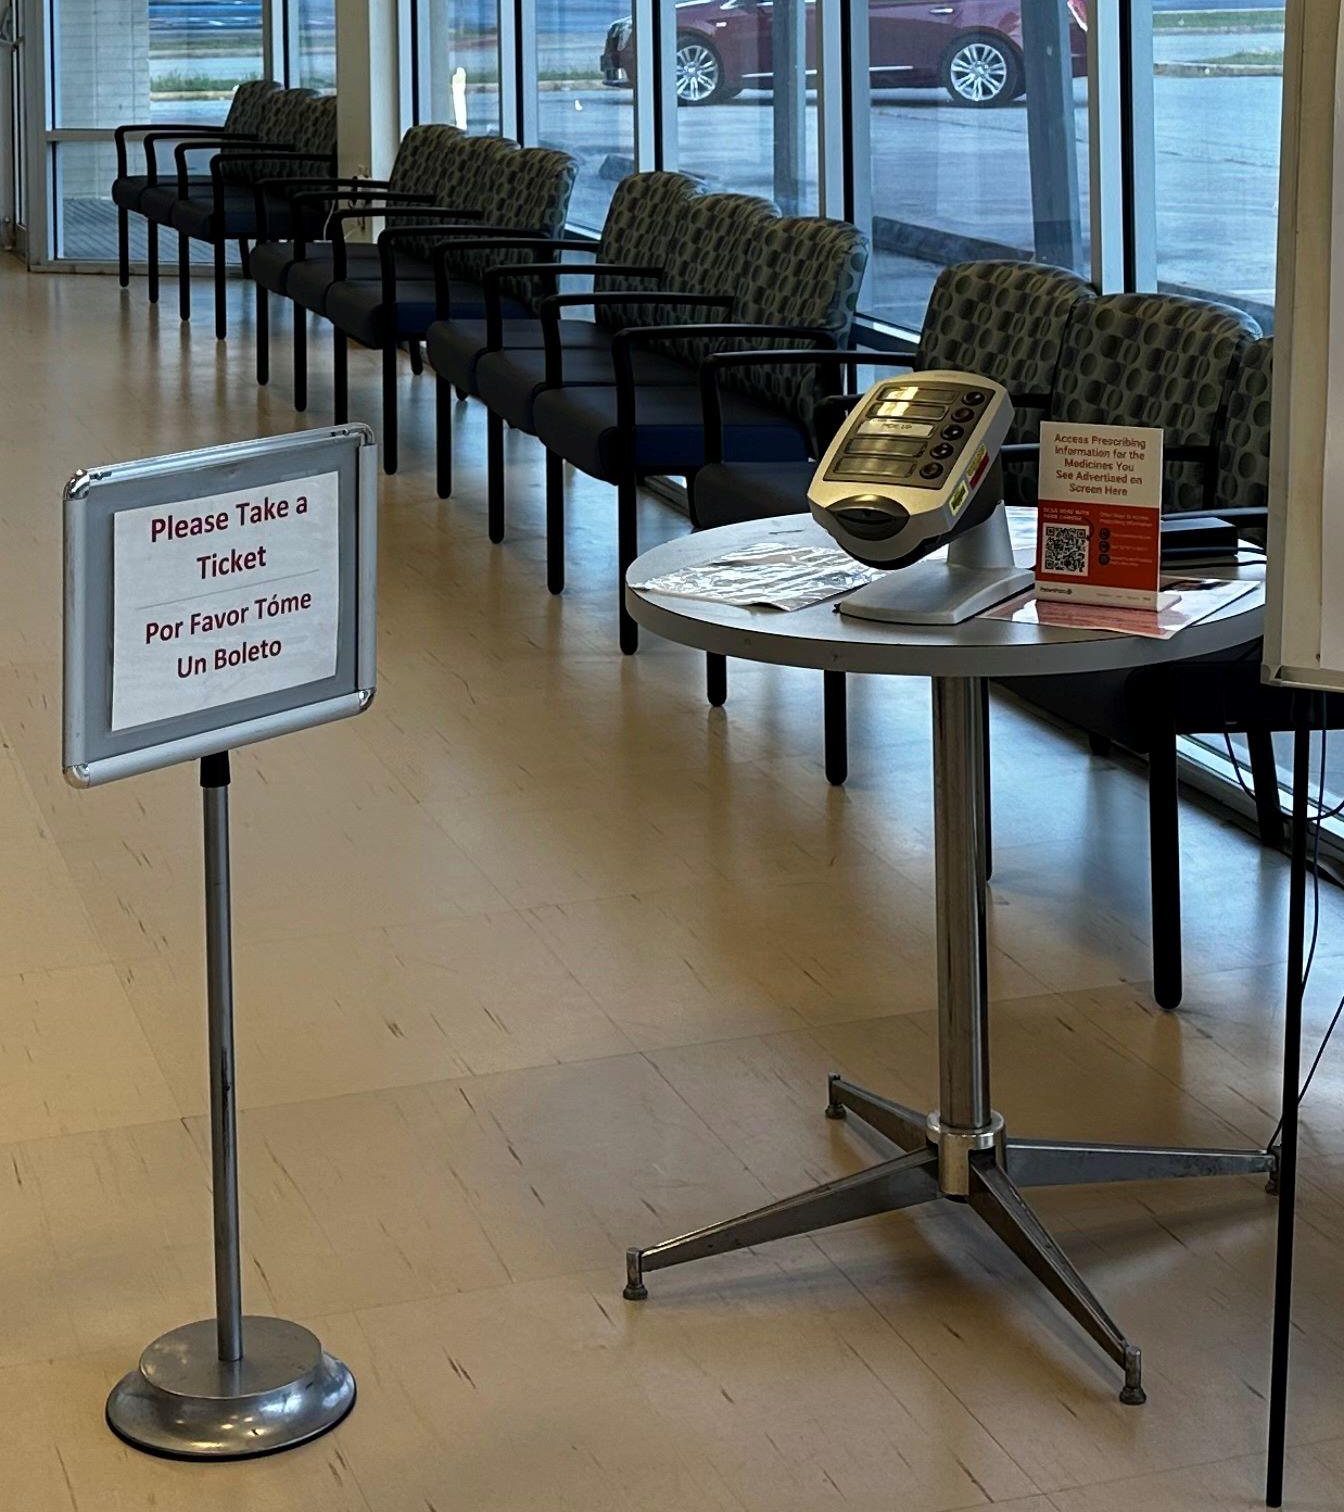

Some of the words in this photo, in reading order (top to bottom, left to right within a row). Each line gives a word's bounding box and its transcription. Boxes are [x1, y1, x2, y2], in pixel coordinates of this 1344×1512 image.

[1053, 433, 1089, 444] Access
[1091, 435, 1146, 450] Prescribing
[1054, 445, 1110, 458] Information
[1113, 448, 1127, 459] for
[1128, 450, 1145, 461] the
[1064, 458, 1114, 470] Medicines
[1116, 461, 1134, 472] You
[1055, 469, 1074, 480] See
[1075, 471, 1128, 484] Advertised
[1129, 476, 1143, 485] on
[1069, 482, 1103, 494] Screen
[1104, 485, 1128, 496] Here
[151, 512, 229, 543] Please
[235, 497, 289, 526] Take
[295, 496, 308, 515] a
[196, 546, 267, 579] Ticket
[146, 621, 184, 645] Por
[190, 607, 249, 635] Favor
[254, 593, 312, 620] Tóme
[177, 655, 207, 679] Un
[214, 640, 282, 670] Boleto
